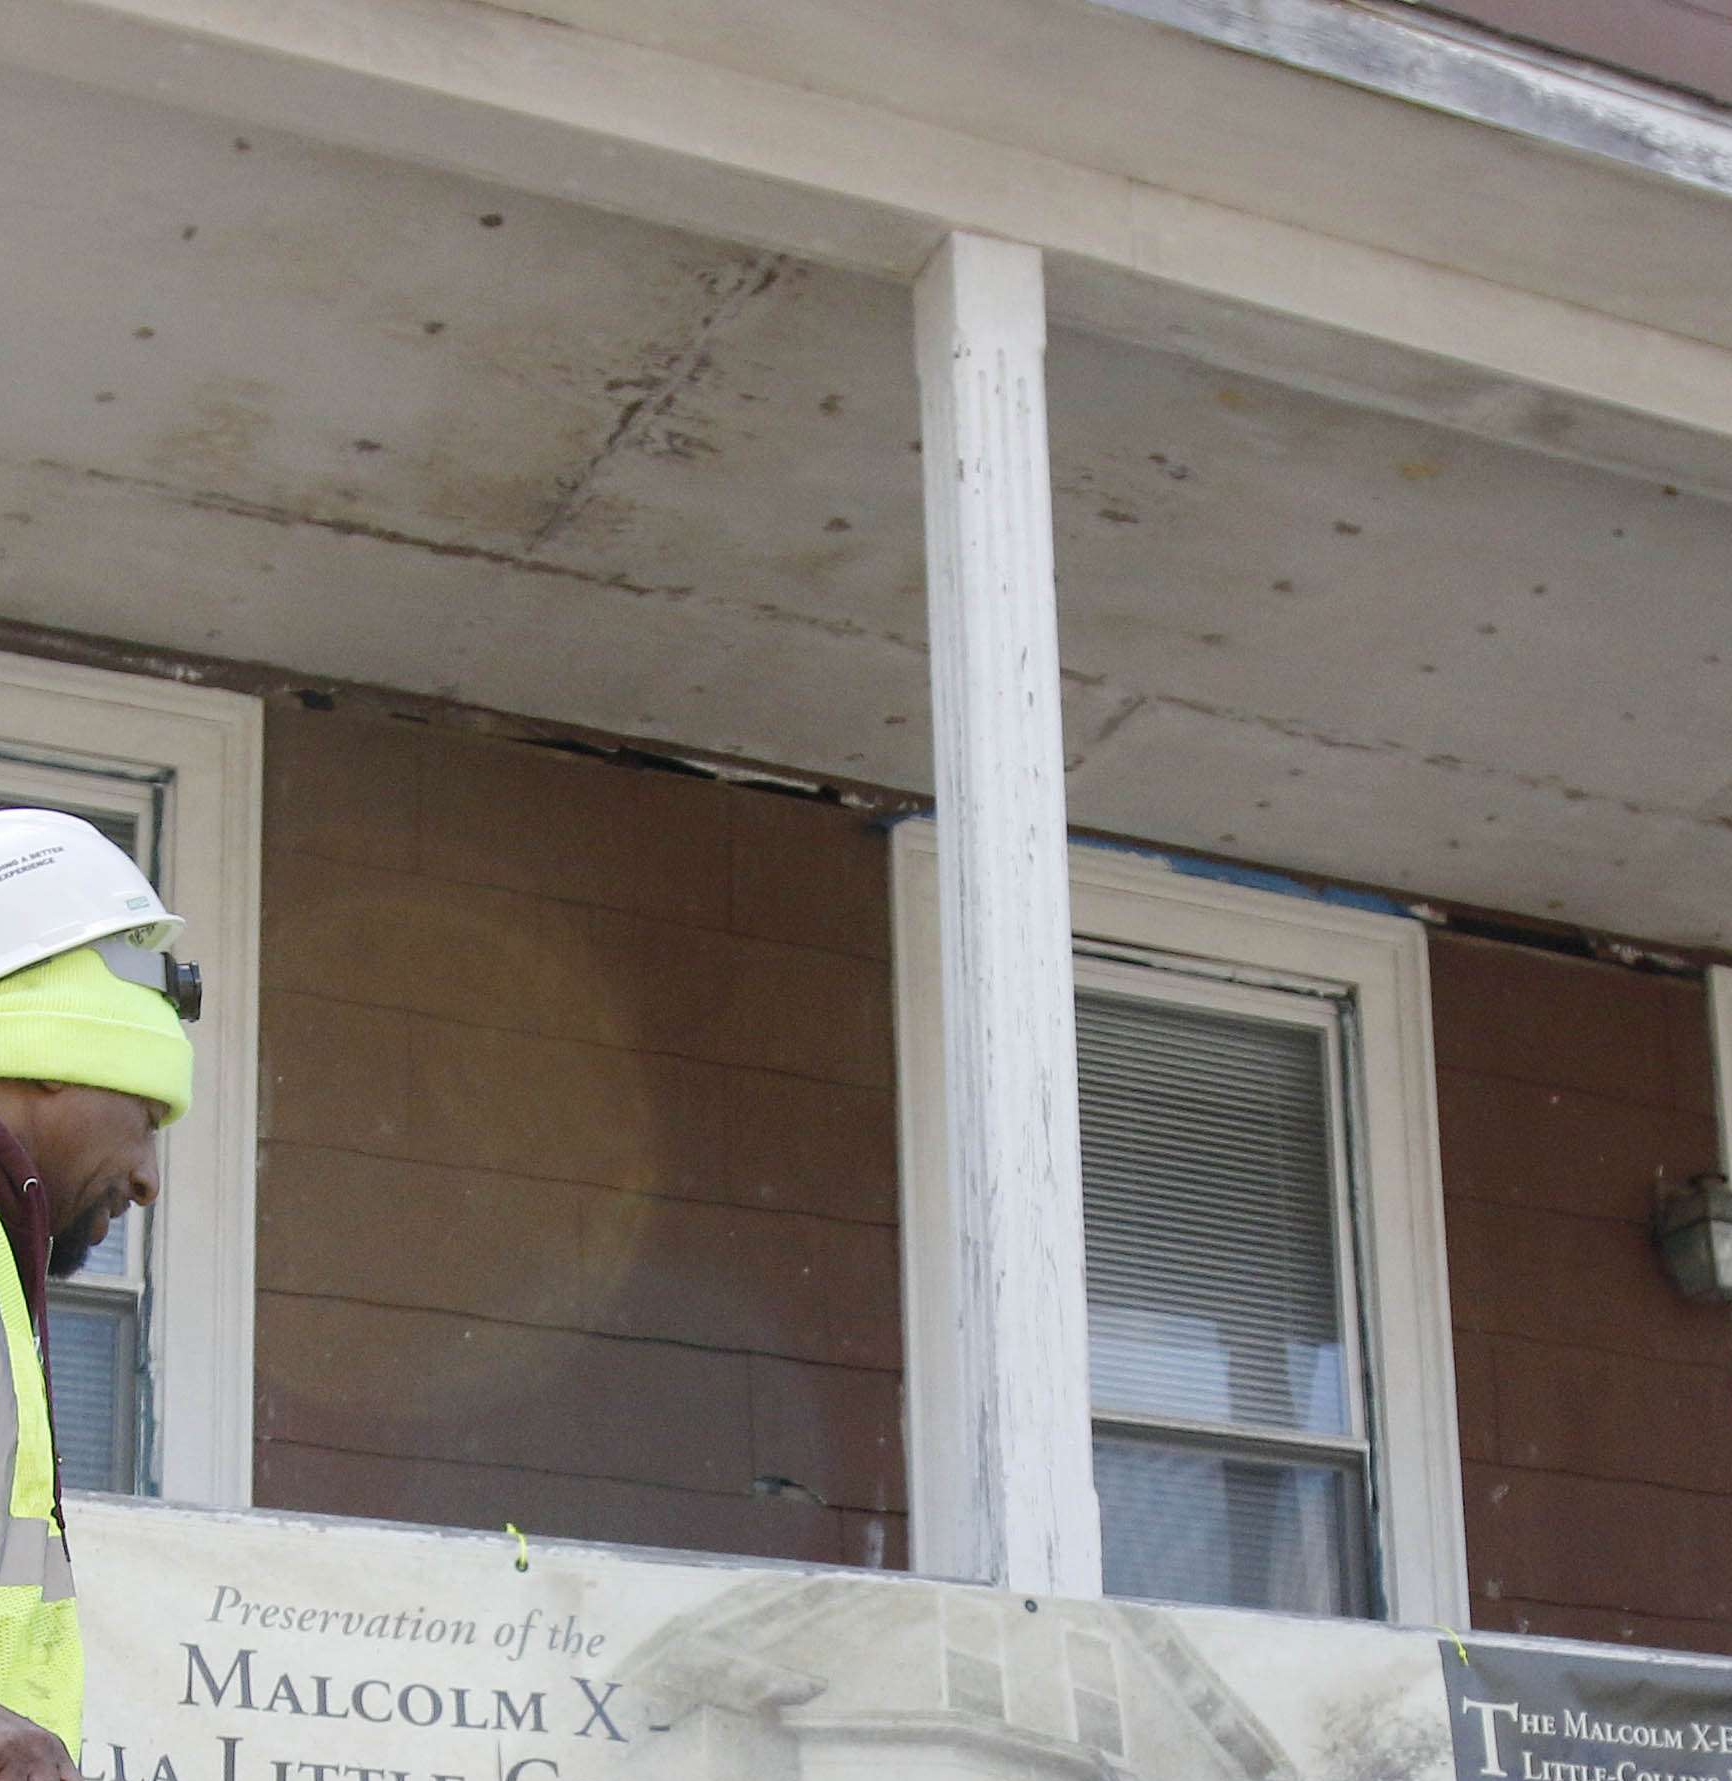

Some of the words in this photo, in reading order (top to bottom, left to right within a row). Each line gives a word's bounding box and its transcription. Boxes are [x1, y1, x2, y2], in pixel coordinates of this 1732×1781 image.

[29, 846, 65, 860] BETTER
[206, 1584, 477, 1646] Preservation
[493, 1605, 538, 1661] of
[547, 1612, 606, 1659] the
[570, 1676, 630, 1744] X
